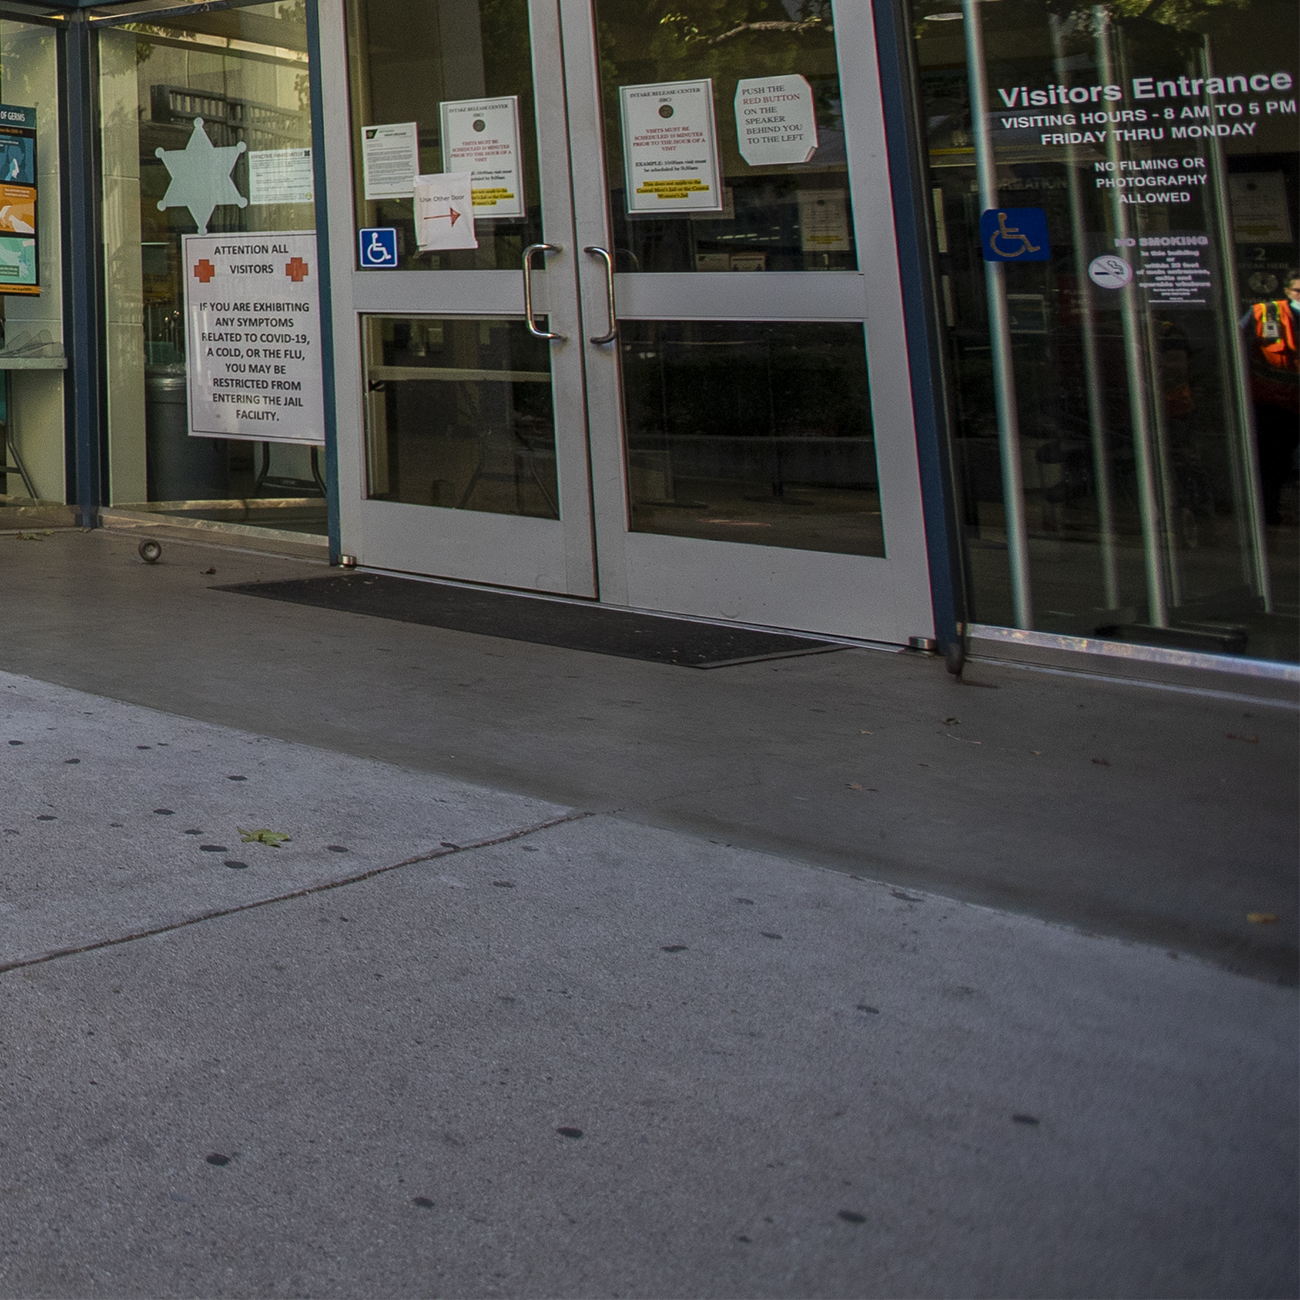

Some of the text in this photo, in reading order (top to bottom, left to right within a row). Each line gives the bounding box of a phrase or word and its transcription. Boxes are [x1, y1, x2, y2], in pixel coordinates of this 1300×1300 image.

[742, 87, 764, 95] PUSH
[998, 72, 1292, 108] Visitors Entrance
[763, 94, 800, 103] BUTTON
[1, 111, 7, 119] OF
[8, 112, 25, 121] GERMS
[1002, 114, 1076, 128] VISITING
[1081, 110, 1148, 124] HOURS
[1164, 108, 1174, 119] 8
[1181, 106, 1210, 118] AM
[1215, 104, 1243, 116] TO
[1249, 103, 1260, 115] 5
[1266, 100, 1296, 114] PM
[745, 116, 785, 125] SPEAKER
[746, 126, 780, 134] BEHIND
[1041, 122, 1256, 145] FRIDAY THRU MONDAY
[781, 134, 803, 142] LEFT
[1094, 158, 1205, 172] NO FILMING OR
[1096, 174, 1207, 188] PHOTOGRAPHY
[1120, 192, 1191, 203] ALLOWED
[1114, 236, 1208, 247] NO SMOKING
[214, 244, 289, 255] ATTENTION ALL
[1254, 248, 1266, 261] 2
[230, 264, 274, 274] VISITORS
[200, 302, 309, 312] IF YOU ARE EXHIBITING
[216, 318, 294, 327] ANY SYMPTOMS
[202, 332, 310, 345] RELATED TO COVID-19,
[207, 348, 305, 361] A COLD, OR THE FLU,
[225, 363, 286, 374] YOU MAY BE
[213, 378, 301, 391] RESTRICTED FROM
[213, 393, 303, 407] ENTERING THE JAIL
[236, 409, 280, 422] FACILITY.
